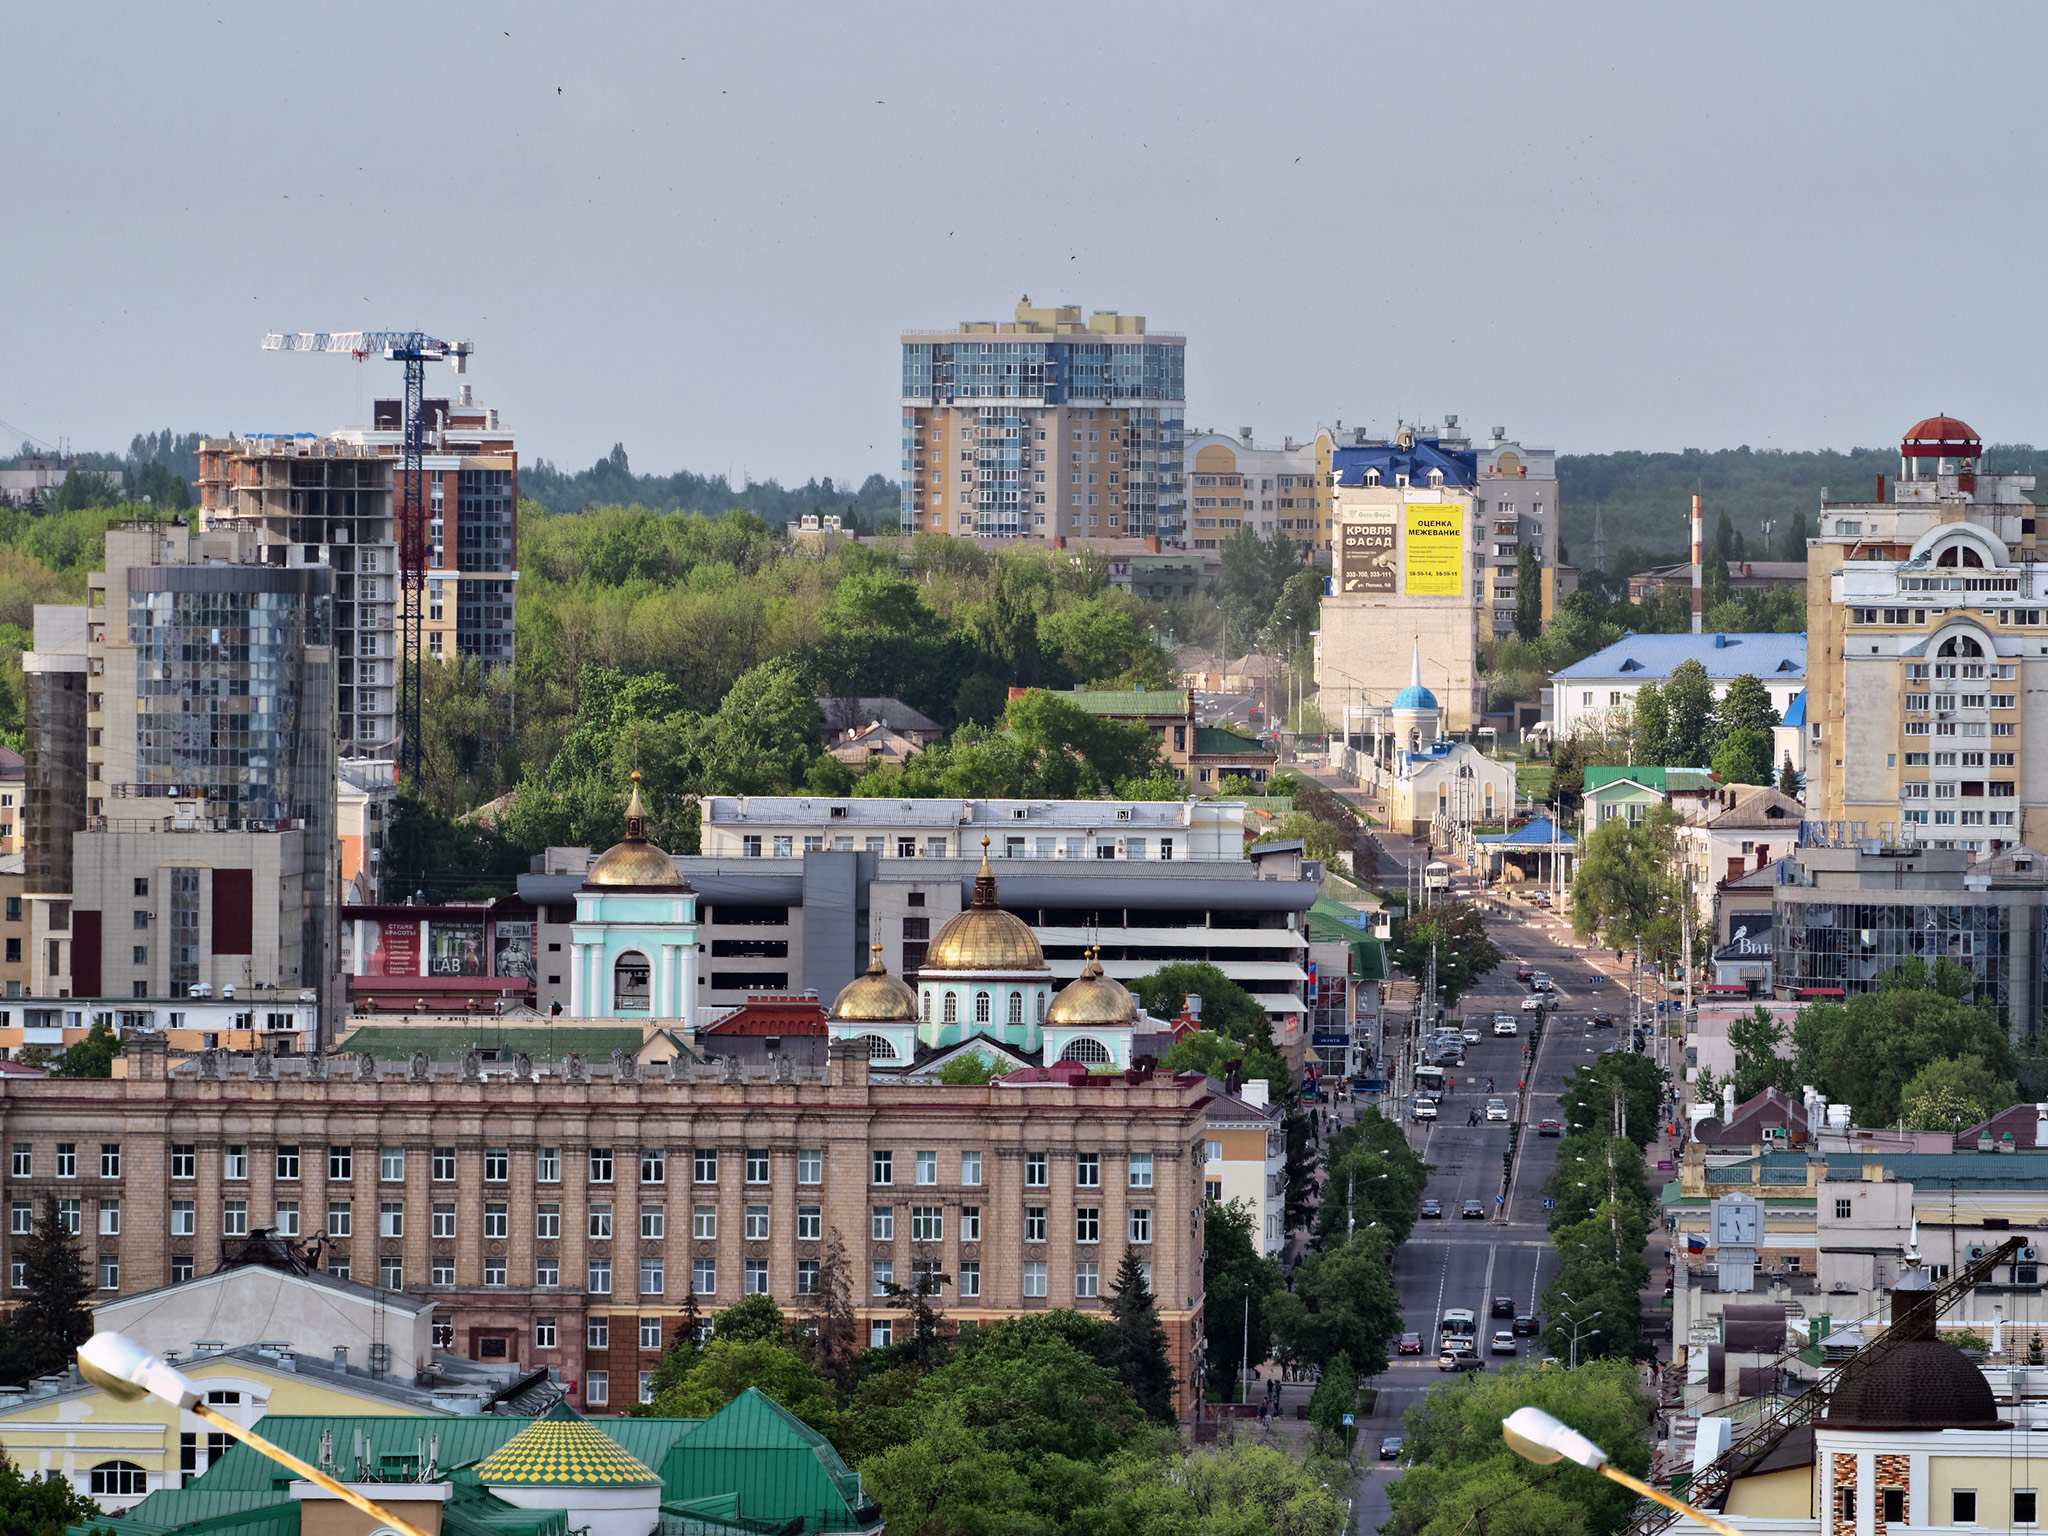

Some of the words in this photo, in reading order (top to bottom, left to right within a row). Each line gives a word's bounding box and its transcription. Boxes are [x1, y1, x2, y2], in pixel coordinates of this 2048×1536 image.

[1346, 526, 1392, 535] КРОВЛЯ
[1345, 537, 1392, 547] ФАСАД
[432, 958, 461, 972] LAB
